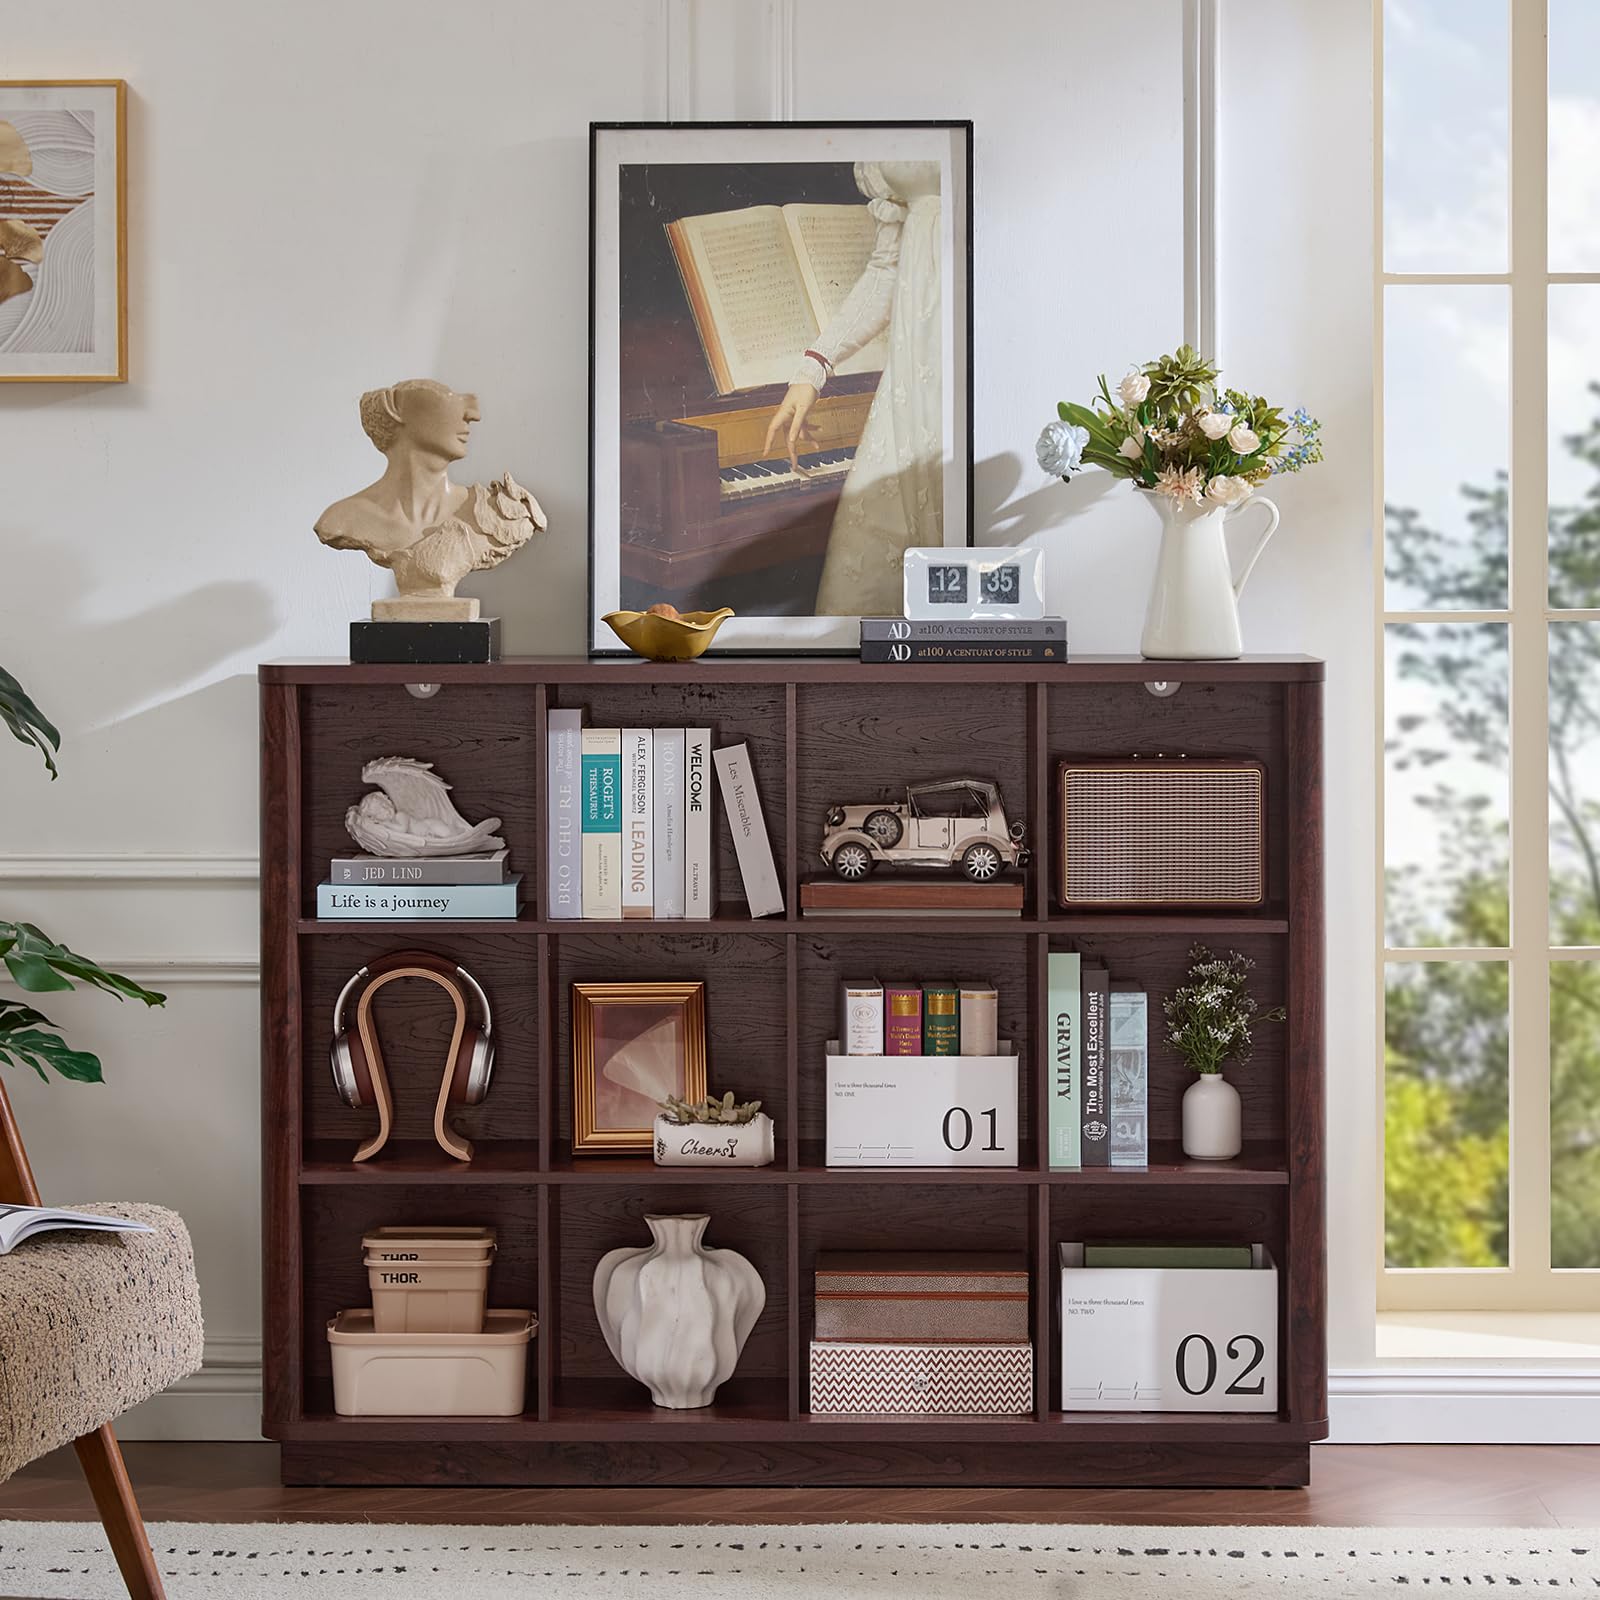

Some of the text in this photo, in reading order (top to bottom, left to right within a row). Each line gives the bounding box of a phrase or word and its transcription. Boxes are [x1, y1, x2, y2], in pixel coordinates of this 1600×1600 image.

[935, 568, 1013, 592] 12 35
[888, 622, 912, 639] AD
[918, 625, 944, 634] at100
[954, 626, 994, 634] CENTURY
[888, 644, 1032, 661] AD at100 A CENTURY OF STYLE
[638, 736, 646, 814] ALEX FERGUSON
[663, 742, 674, 796] ROOMS
[690, 743, 702, 812] WELCOME
[728, 762, 737, 780] Les
[590, 768, 598, 820] THESAURUS
[603, 768, 614, 820] ROGET'S
[362, 867, 423, 880] JED LIND
[632, 821, 645, 893] LEADING
[330, 894, 450, 912] Life is a journey
[1056, 1012, 1071, 1100] GRAVITY
[1086, 992, 1098, 1114] The Most Excellent
[680, 1138, 729, 1157] Cheers
[942, 1107, 1005, 1152] 01
[380, 1273, 421, 1283] THOR.
[1175, 1333, 1265, 1396] 02
